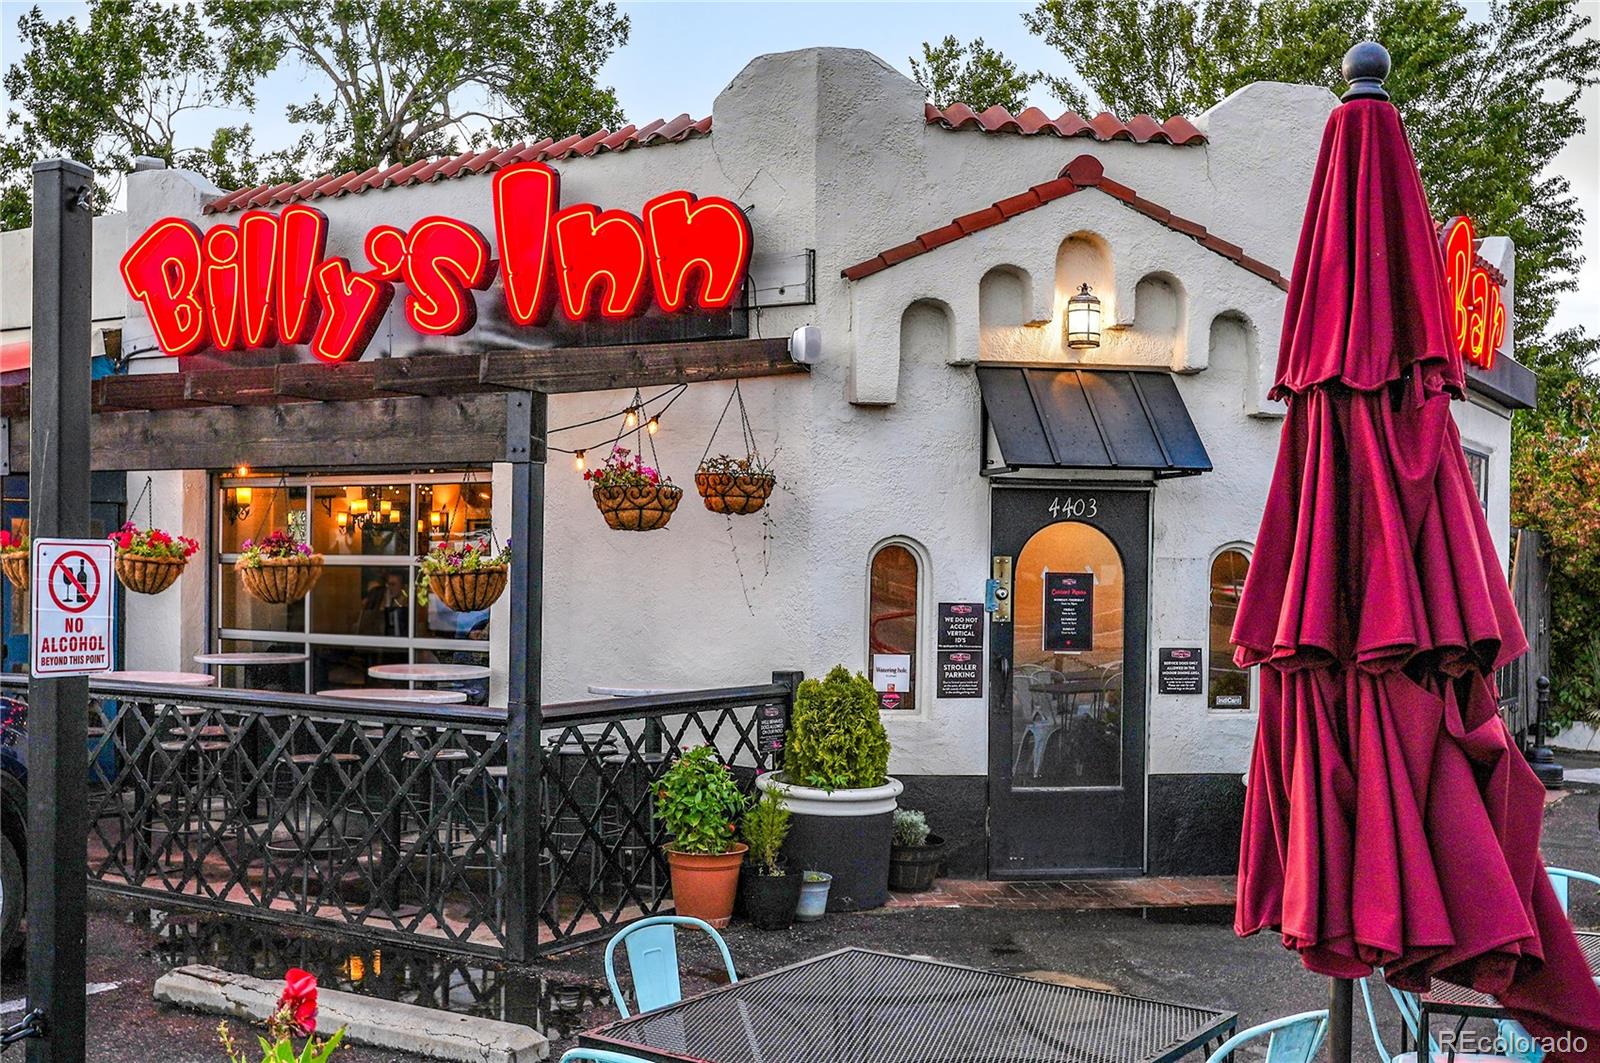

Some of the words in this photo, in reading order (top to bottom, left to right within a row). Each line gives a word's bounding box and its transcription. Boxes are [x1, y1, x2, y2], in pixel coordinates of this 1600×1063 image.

[119, 205, 493, 363] Billy's
[492, 160, 754, 326] Inn
[1444, 216, 1507, 370] Bar
[1048, 496, 1098, 518] 4403
[65, 617, 84, 633] NO
[41, 636, 105, 653] ALCOHOL
[41, 656, 68, 667] BEYOND
[69, 655, 84, 665] THIS
[85, 654, 105, 664] POINT
